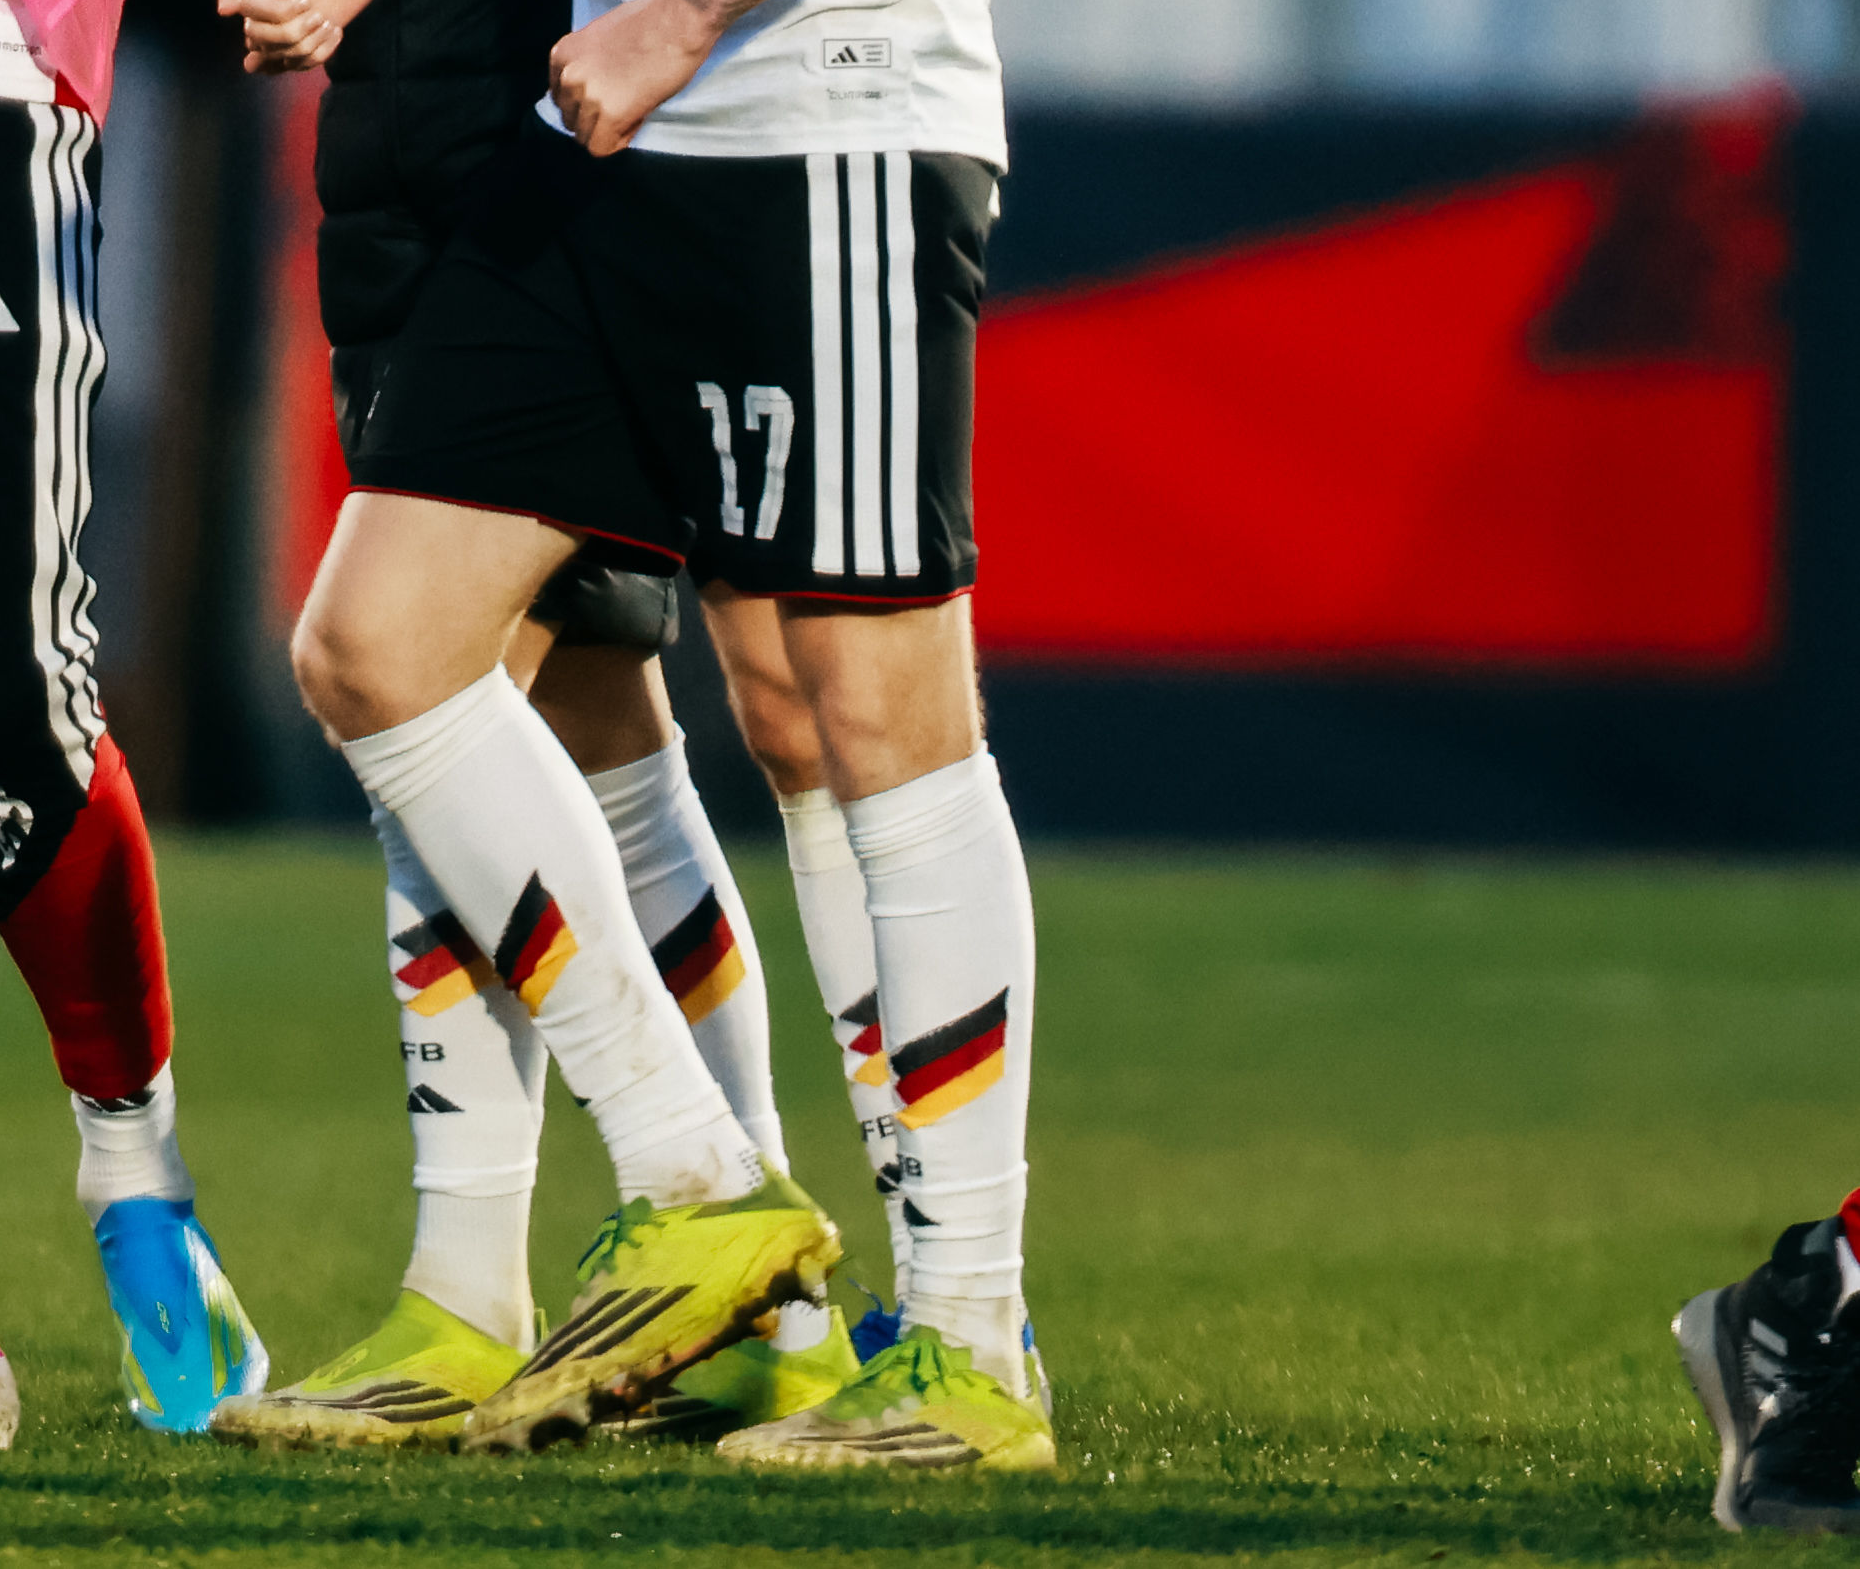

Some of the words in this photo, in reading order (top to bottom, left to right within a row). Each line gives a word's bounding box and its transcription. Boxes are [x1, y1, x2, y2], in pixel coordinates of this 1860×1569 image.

[696, 382, 795, 540] 17
[400, 1041, 445, 1062] FB
[861, 1114, 896, 1142] FB
